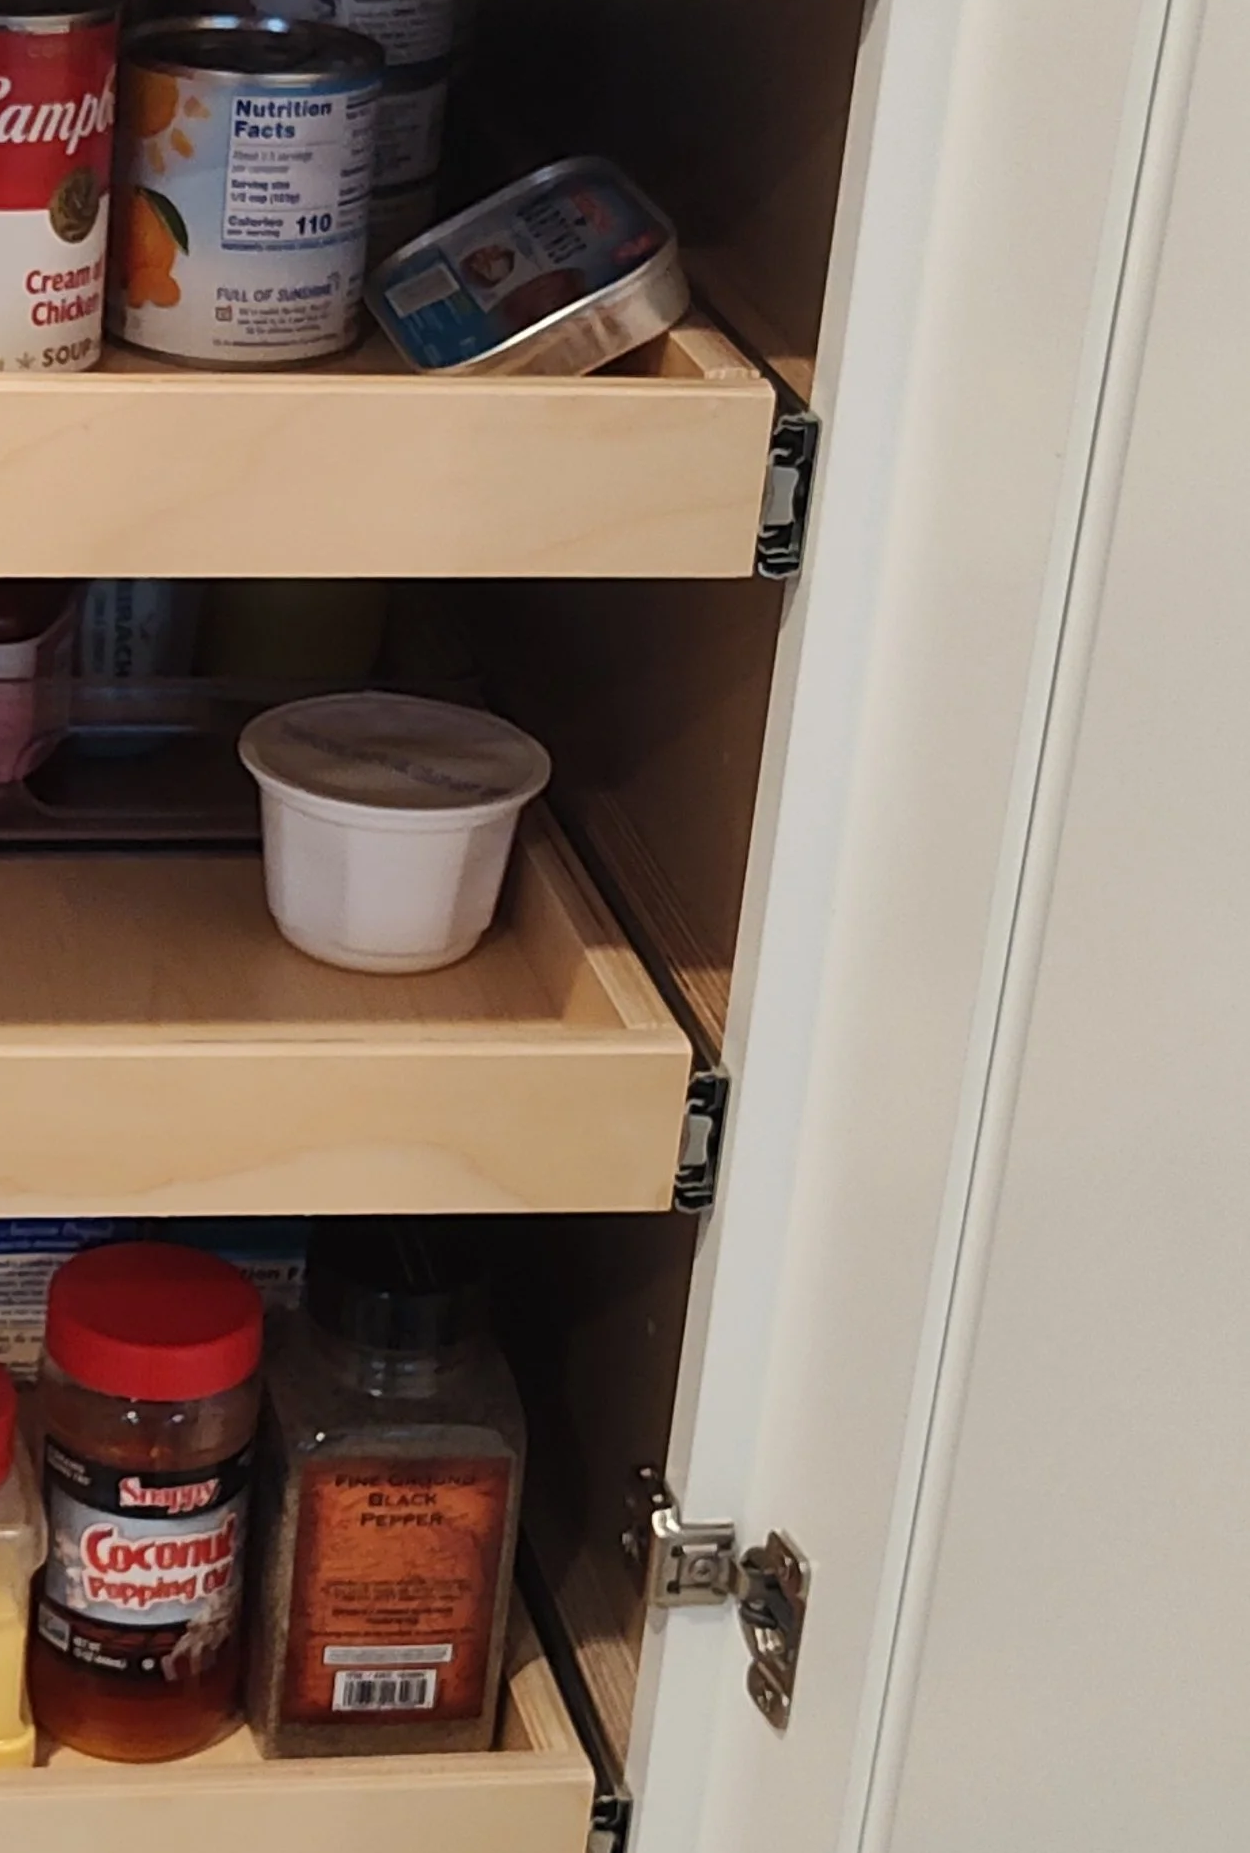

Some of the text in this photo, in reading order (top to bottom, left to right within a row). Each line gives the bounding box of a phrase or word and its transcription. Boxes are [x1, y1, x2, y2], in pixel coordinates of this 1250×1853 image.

[236, 100, 333, 118] Nutrition
[234, 121, 295, 138] Facts
[296, 213, 333, 235] 110
[26, 265, 90, 294] Cream
[253, 289, 274, 302] OF
[42, 338, 92, 367] SOUP
[368, 1492, 437, 1508] BLACK
[360, 1513, 444, 1527] PEPPER
[84, 1513, 236, 1575] Coconut
